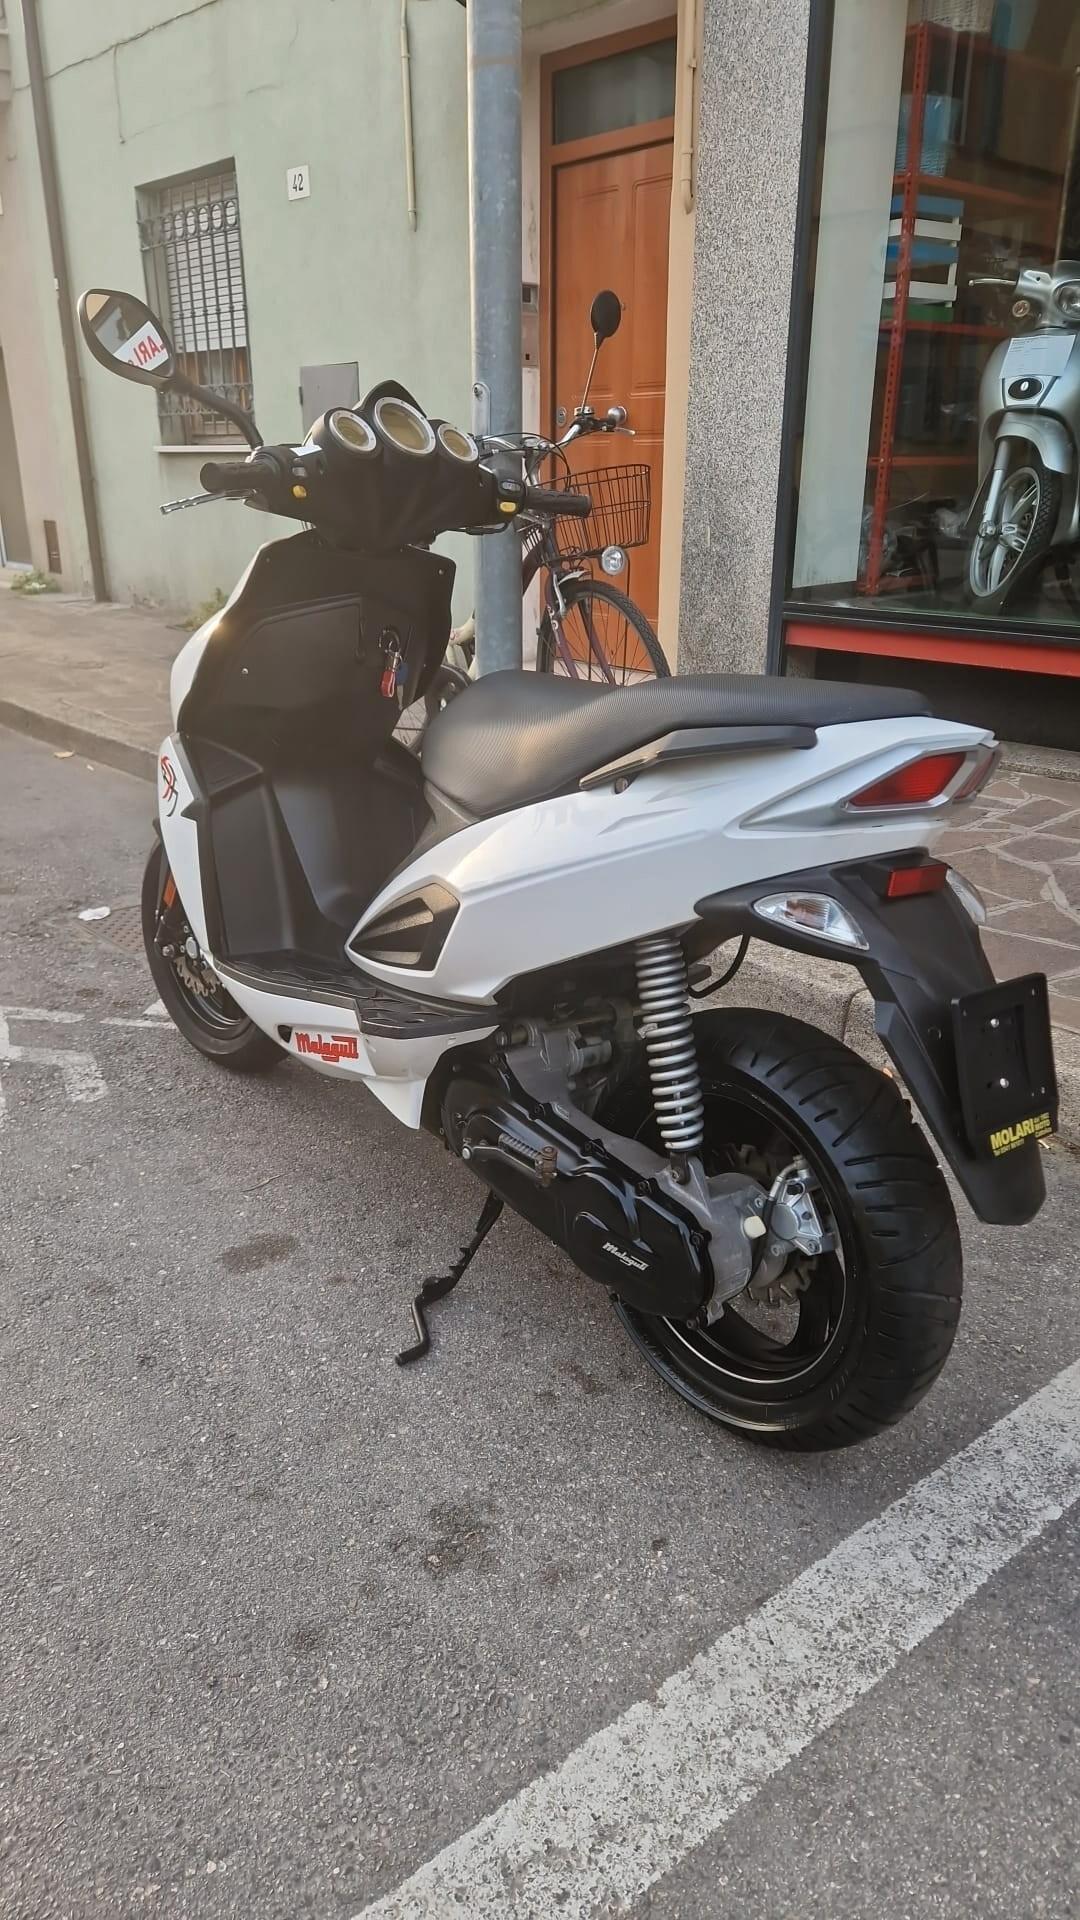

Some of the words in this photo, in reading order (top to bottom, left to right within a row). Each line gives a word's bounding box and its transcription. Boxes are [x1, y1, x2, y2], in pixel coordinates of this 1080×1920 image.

[292, 173, 304, 192] 42
[990, 1118, 1035, 1150] MOLARI
[602, 1241, 649, 1271] Malaguti
